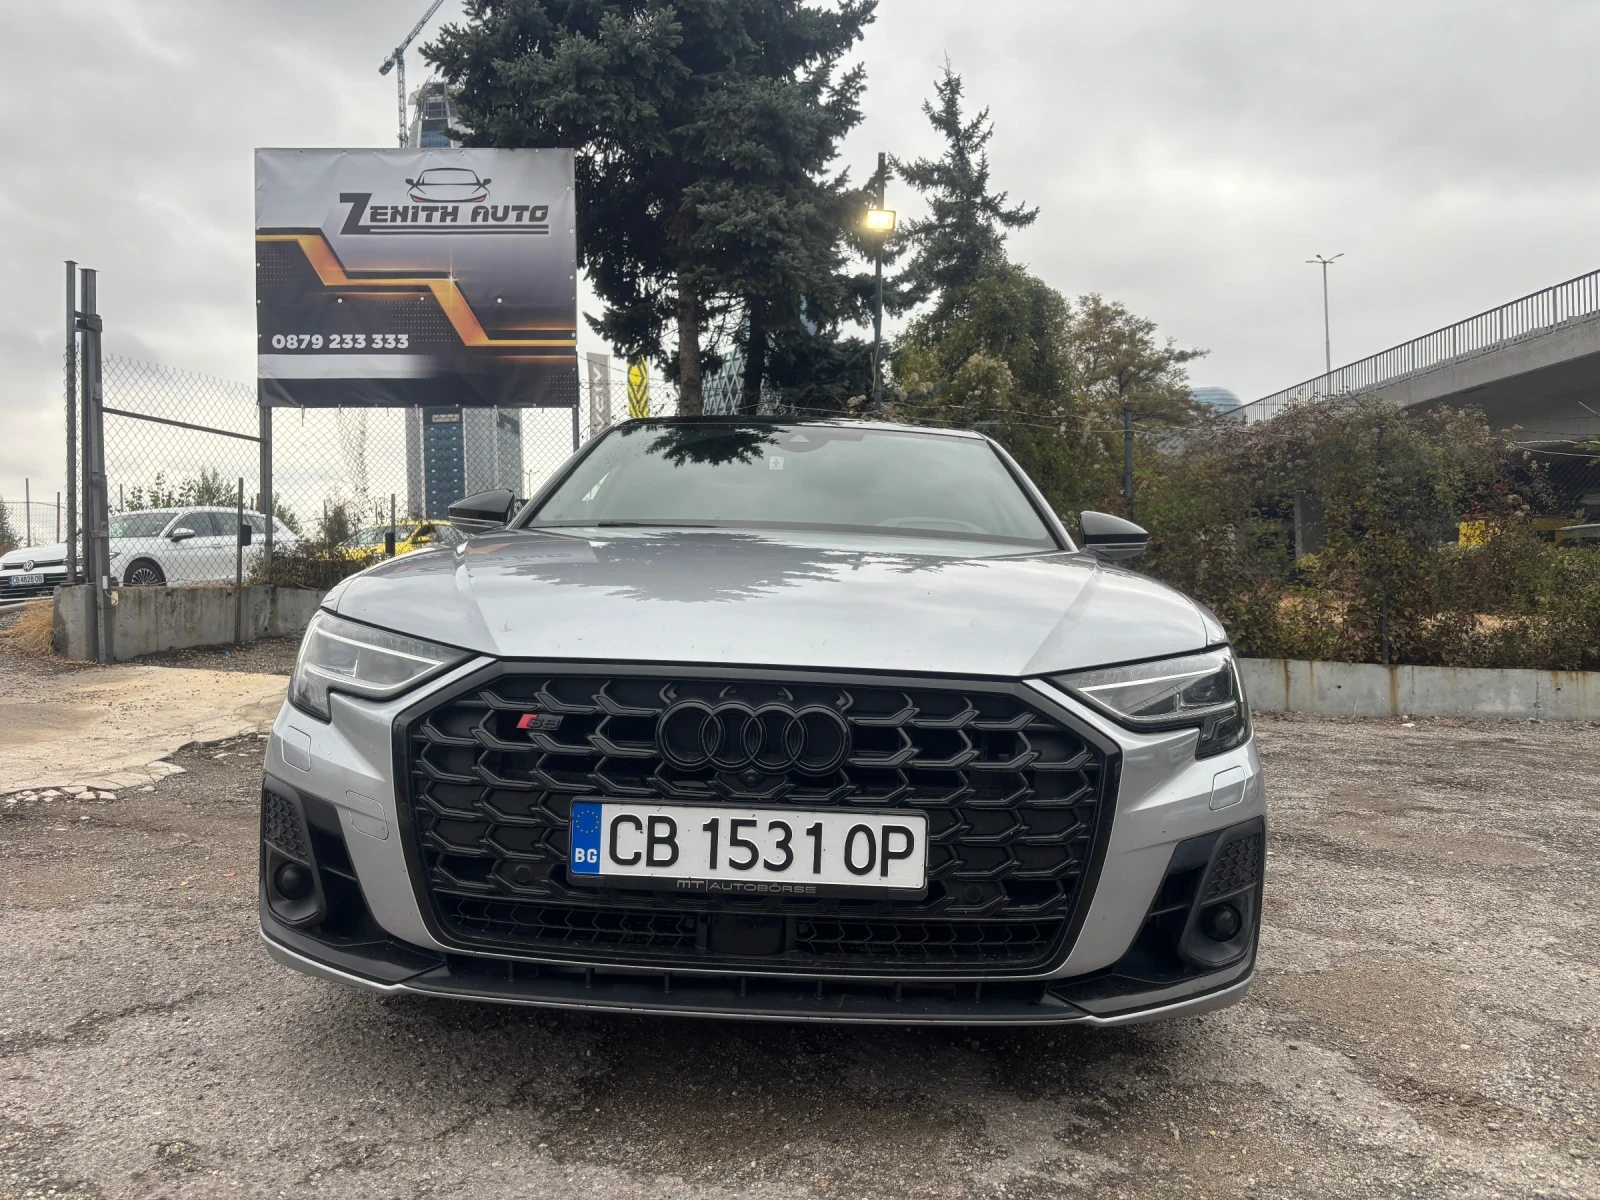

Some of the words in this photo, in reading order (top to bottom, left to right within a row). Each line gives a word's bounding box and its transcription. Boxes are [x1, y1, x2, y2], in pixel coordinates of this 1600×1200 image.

[340, 193, 459, 235] ZENITH
[471, 205, 549, 222] AUTO
[271, 334, 324, 349] 0879
[328, 334, 367, 349] 233
[371, 334, 409, 349] 333
[526, 717, 561, 729] S8
[609, 814, 679, 867] CB
[702, 817, 822, 874] 1531
[844, 823, 914, 877] OP
[574, 848, 598, 864] BG
